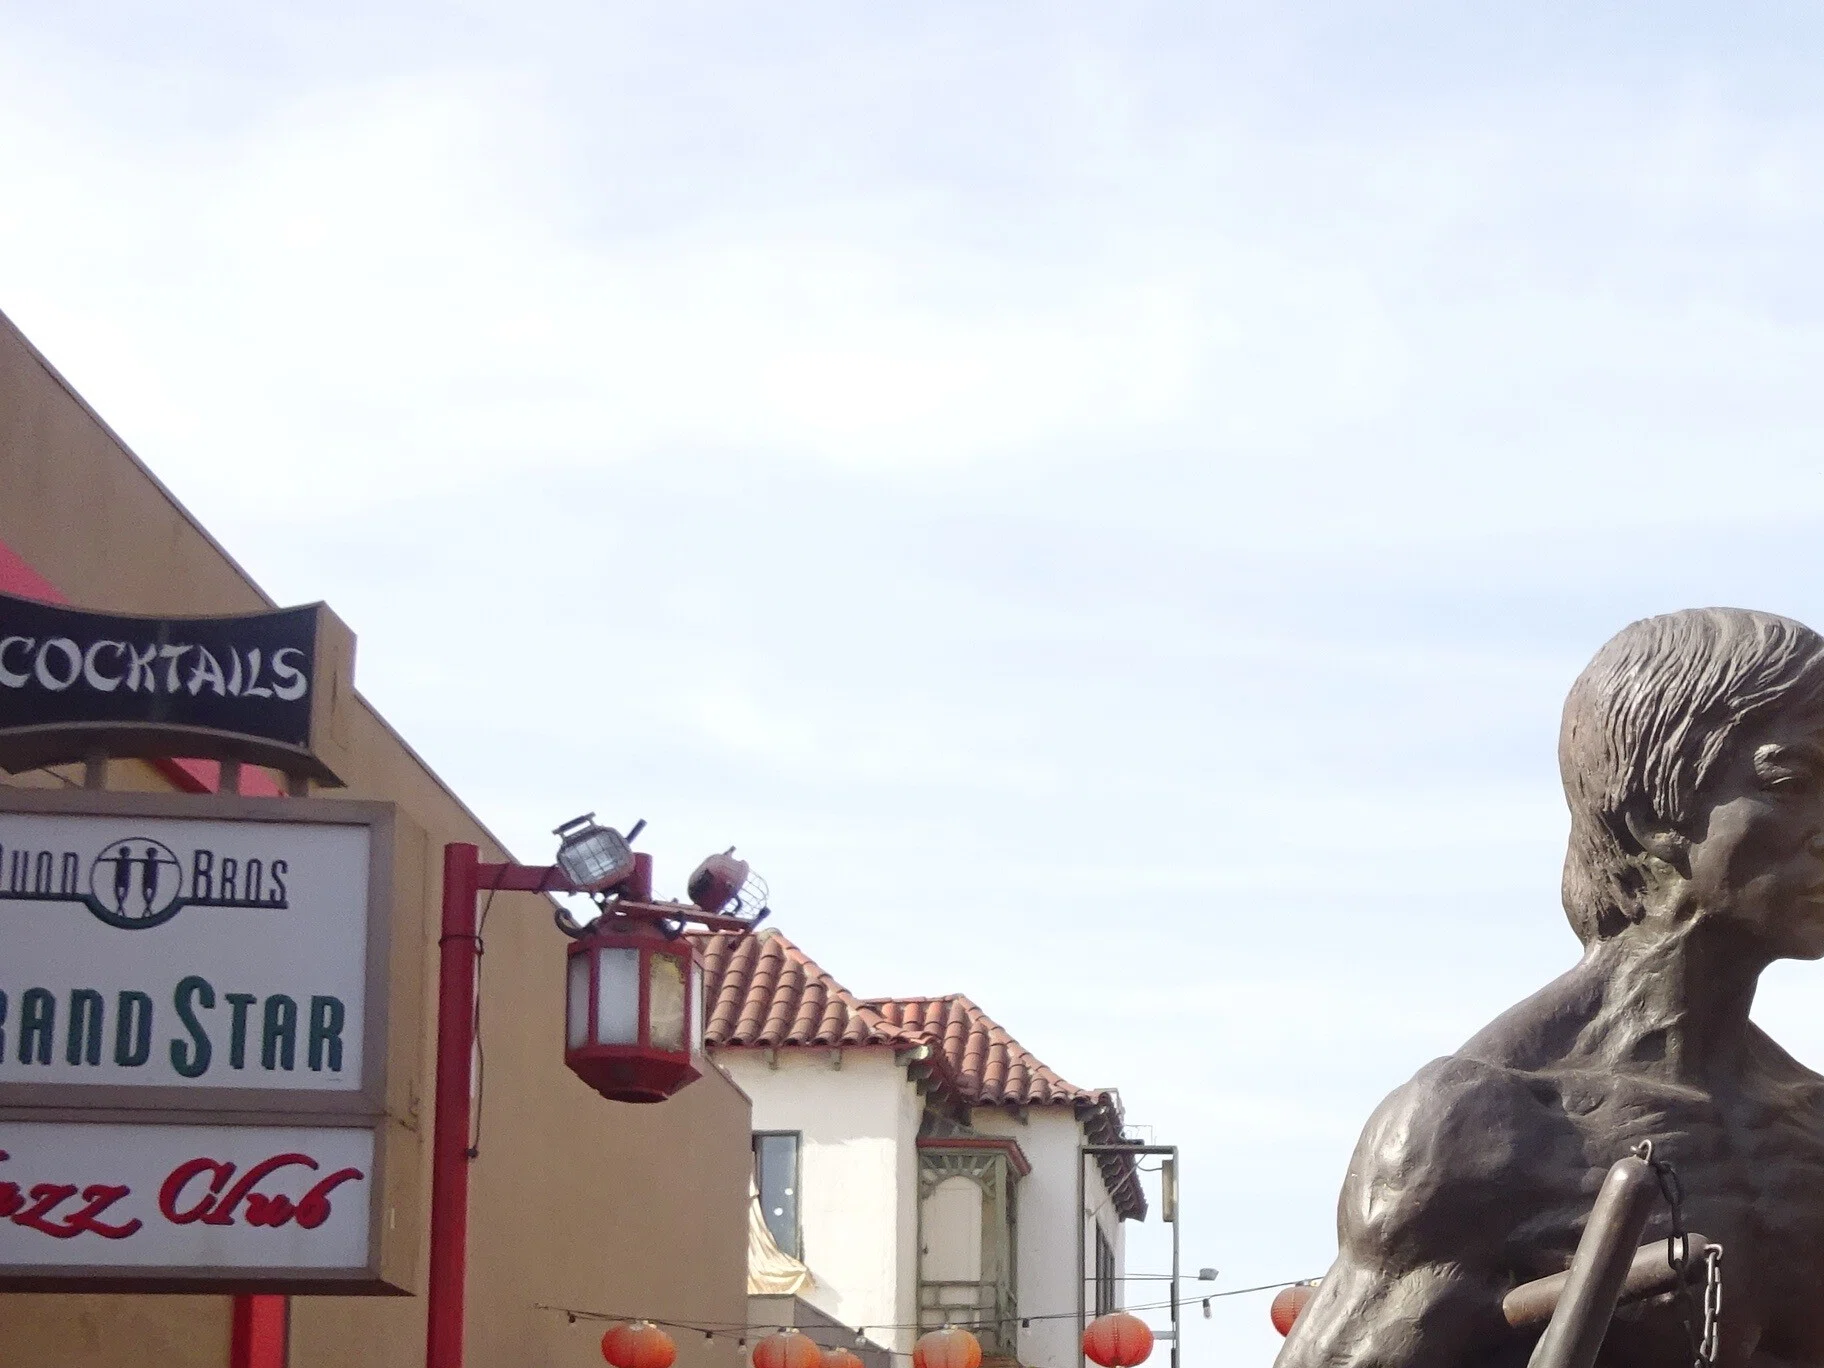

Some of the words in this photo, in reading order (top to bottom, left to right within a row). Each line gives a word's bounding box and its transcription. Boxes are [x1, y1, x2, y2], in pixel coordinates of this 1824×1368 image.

[0, 636, 308, 701] COCKTAILS
[0, 987, 153, 1069] AND
[170, 975, 346, 1079] STAR
[158, 1152, 365, 1230] Club
